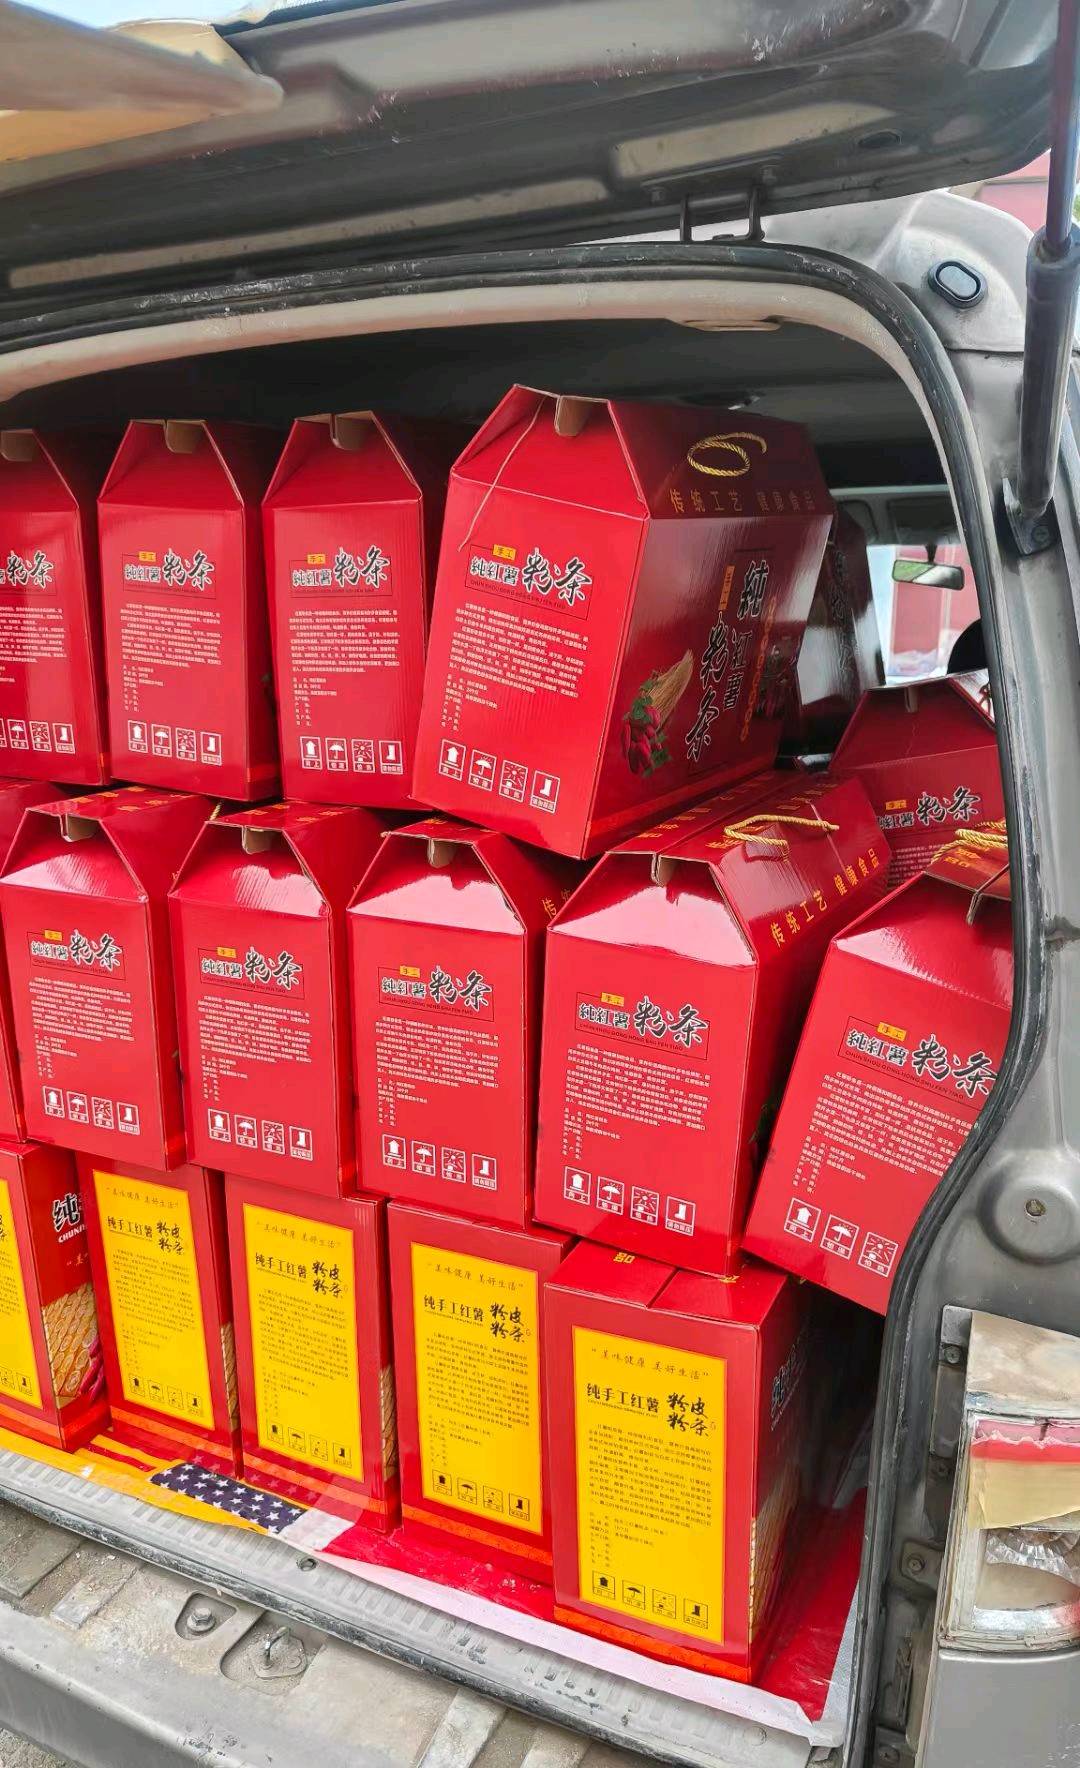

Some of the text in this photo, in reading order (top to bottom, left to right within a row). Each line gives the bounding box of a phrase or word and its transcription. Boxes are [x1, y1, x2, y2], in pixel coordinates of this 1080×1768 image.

[670, 488, 742, 513] 传统工艺
[7, 551, 54, 588] 粉条
[163, 548, 215, 591] 粉条
[333, 545, 390, 588] 粉条
[522, 547, 592, 606] 粉条
[916, 785, 981, 826] 粉条
[770, 890, 828, 948] 传统工艺
[833, 848, 880, 896] 健康食品
[70, 929, 122, 971] 粉条
[245, 946, 302, 990] 粉条
[428, 965, 492, 1011] 粉条
[633, 995, 708, 1048] 粉条
[911, 1033, 998, 1098] 粉条
[255, 1252, 307, 1279] 纯手工红薯
[313, 1279, 343, 1299] 粉条
[424, 1295, 483, 1322] 纯手工红薯
[490, 1302, 524, 1326] 粉皮
[490, 1320, 525, 1343] 粉条
[587, 1383, 659, 1413] 纯手工红薯
[667, 1392, 708, 1419] 粉皮
[667, 1411, 709, 1437] 粉条
